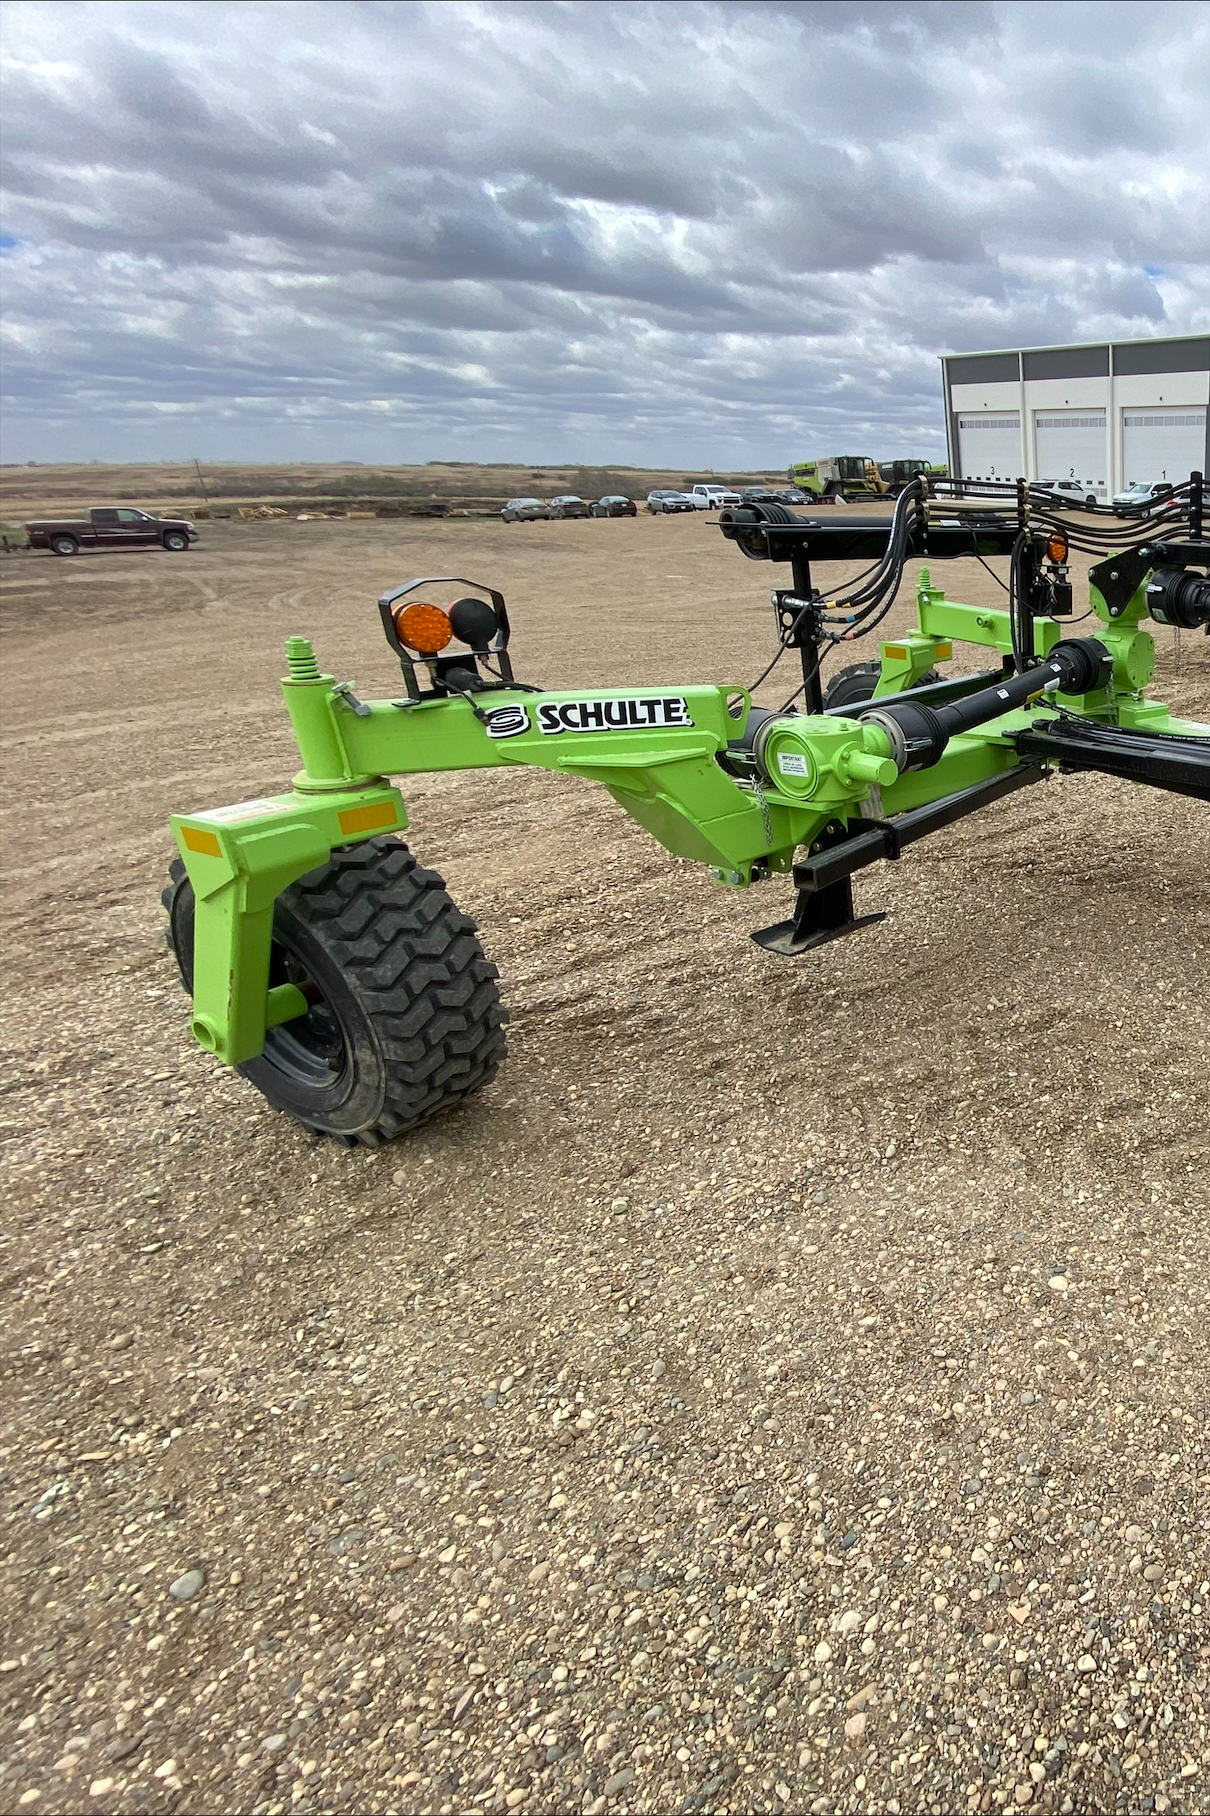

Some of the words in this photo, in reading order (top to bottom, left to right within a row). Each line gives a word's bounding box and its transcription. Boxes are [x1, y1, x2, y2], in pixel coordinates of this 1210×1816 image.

[990, 466, 995, 475] 3
[1069, 468, 1075, 478] 2
[1161, 470, 1166, 480] 1
[539, 698, 683, 730] SCHULTE
